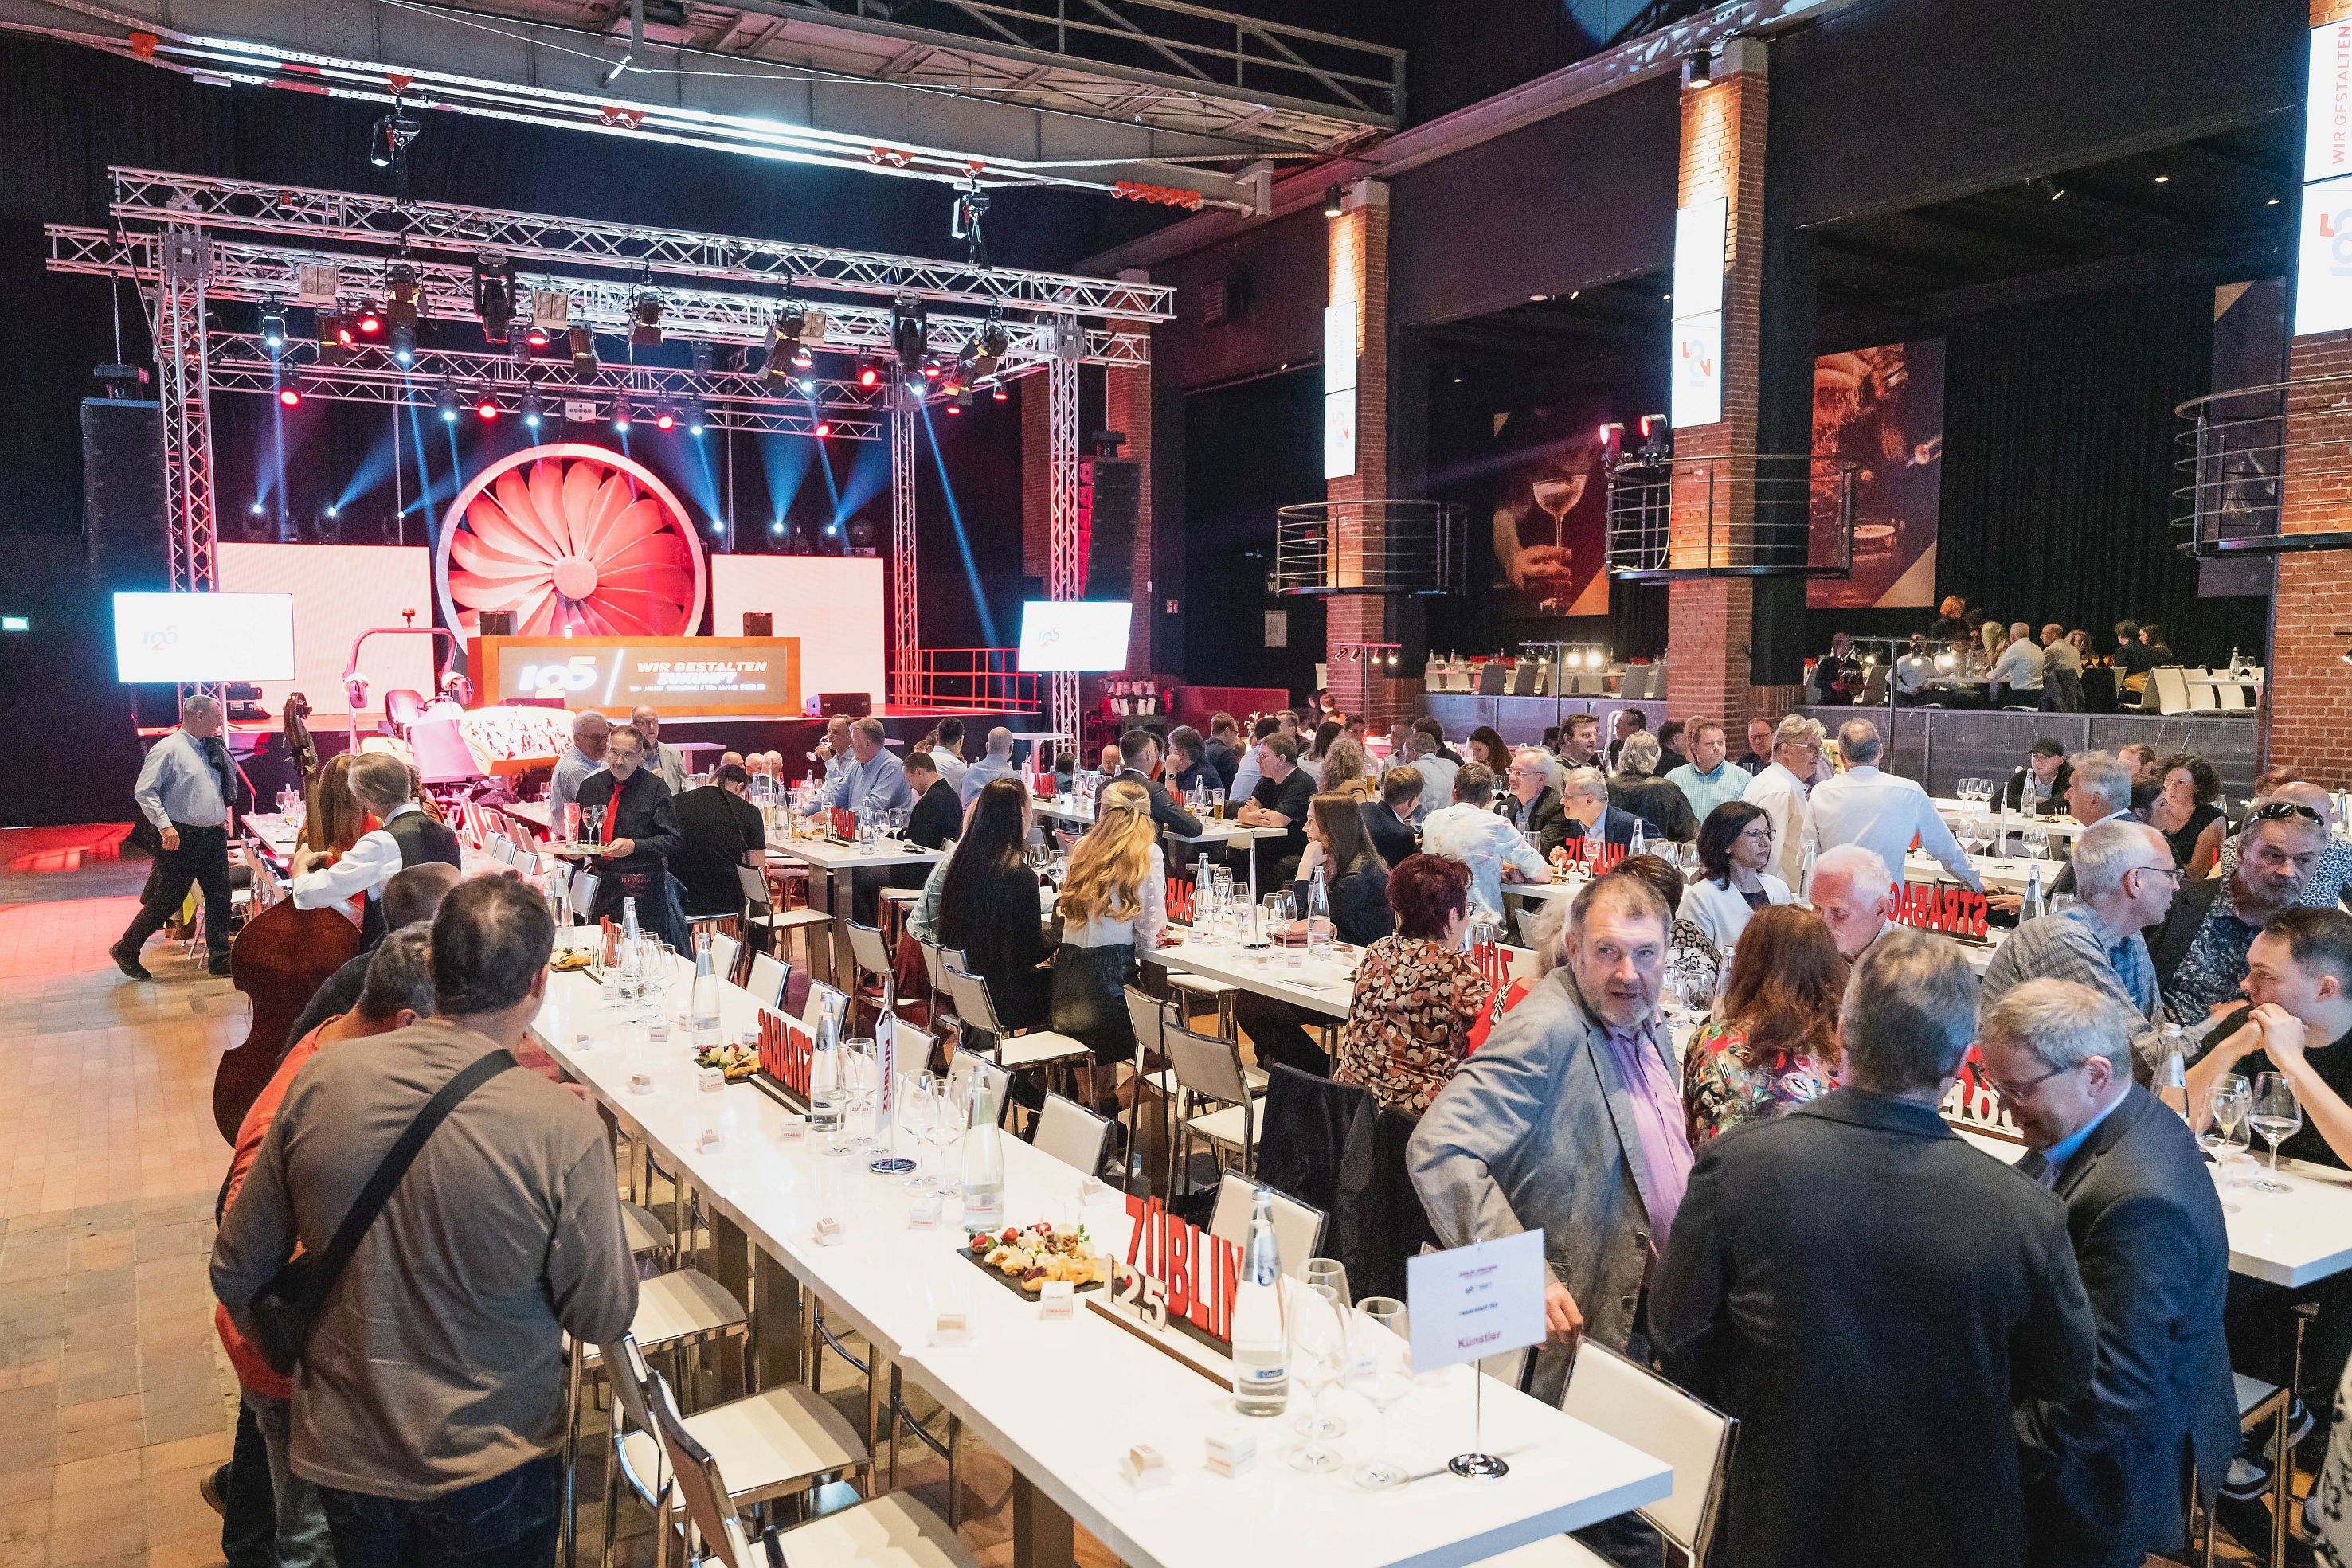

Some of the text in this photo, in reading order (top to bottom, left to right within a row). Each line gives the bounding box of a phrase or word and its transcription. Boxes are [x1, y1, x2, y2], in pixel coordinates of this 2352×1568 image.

[2333, 26, 2351, 165] WIR GESTALTEN
[519, 655, 597, 699] 125
[636, 661, 768, 673] WIR GESTALTEN
[1555, 858, 1591, 879] 125
[1125, 1193, 1244, 1342] ZÜBLIN
[1097, 1253, 1168, 1331] 125
[1458, 1331, 1501, 1349] Künstler
